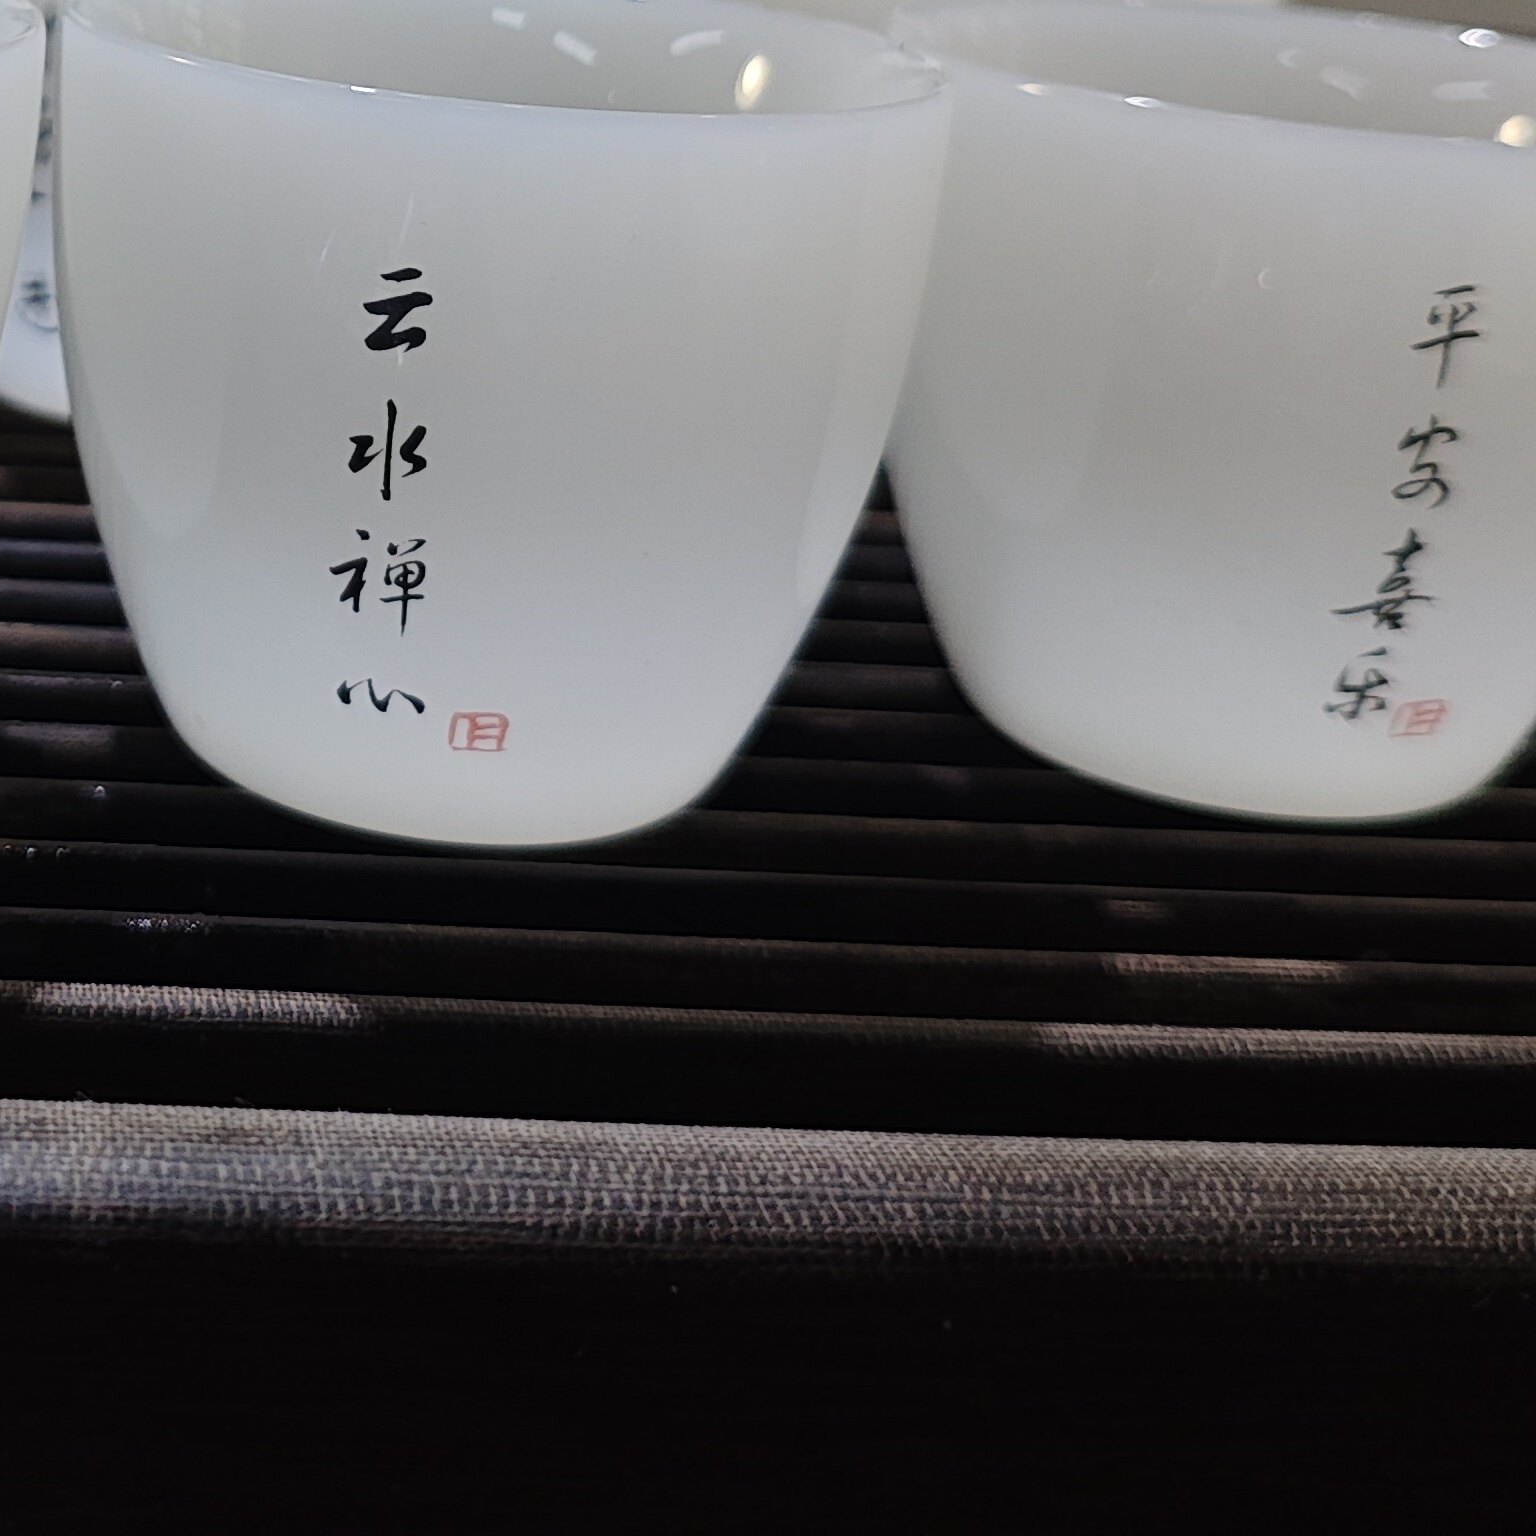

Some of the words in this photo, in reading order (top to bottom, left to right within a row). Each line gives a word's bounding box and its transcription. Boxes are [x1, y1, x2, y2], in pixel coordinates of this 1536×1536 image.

[328, 267, 434, 716] 云水禅心
[1323, 284, 1480, 721] 平安喜乐
